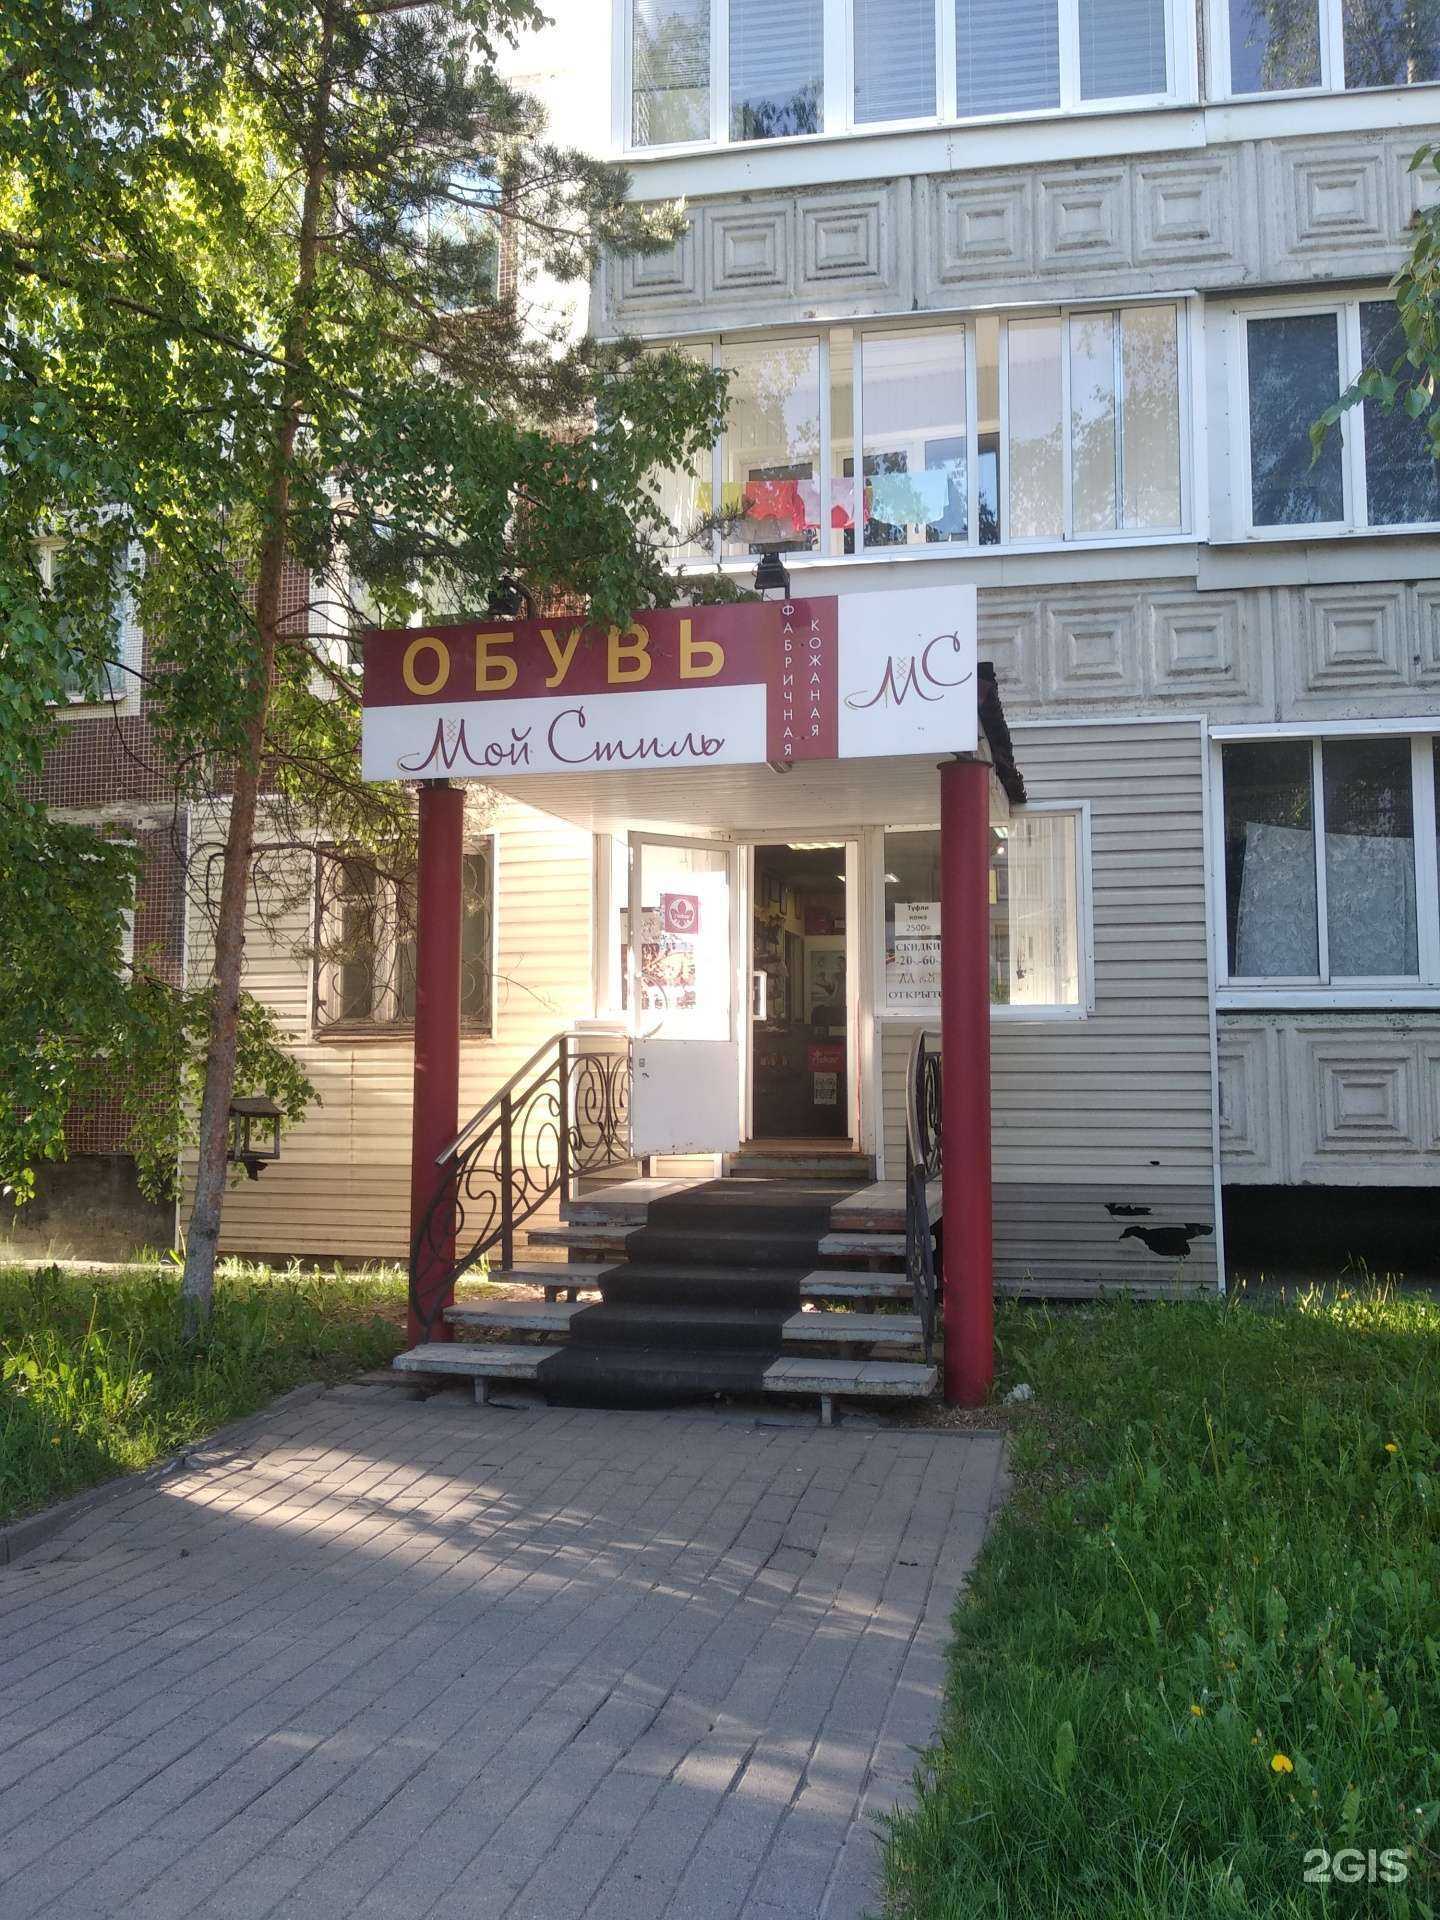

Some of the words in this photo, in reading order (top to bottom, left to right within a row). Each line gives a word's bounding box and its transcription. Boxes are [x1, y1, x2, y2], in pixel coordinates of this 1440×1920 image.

[402, 618, 725, 696] ОБУВЬ
[782, 604, 795, 757] ФАБРИЧНАЯ
[808, 618, 823, 737] КОЖАНАЯ
[397, 716, 533, 774] Мой
[547, 704, 726, 764] Стиль
[895, 942, 941, 953] СКИДКИ
